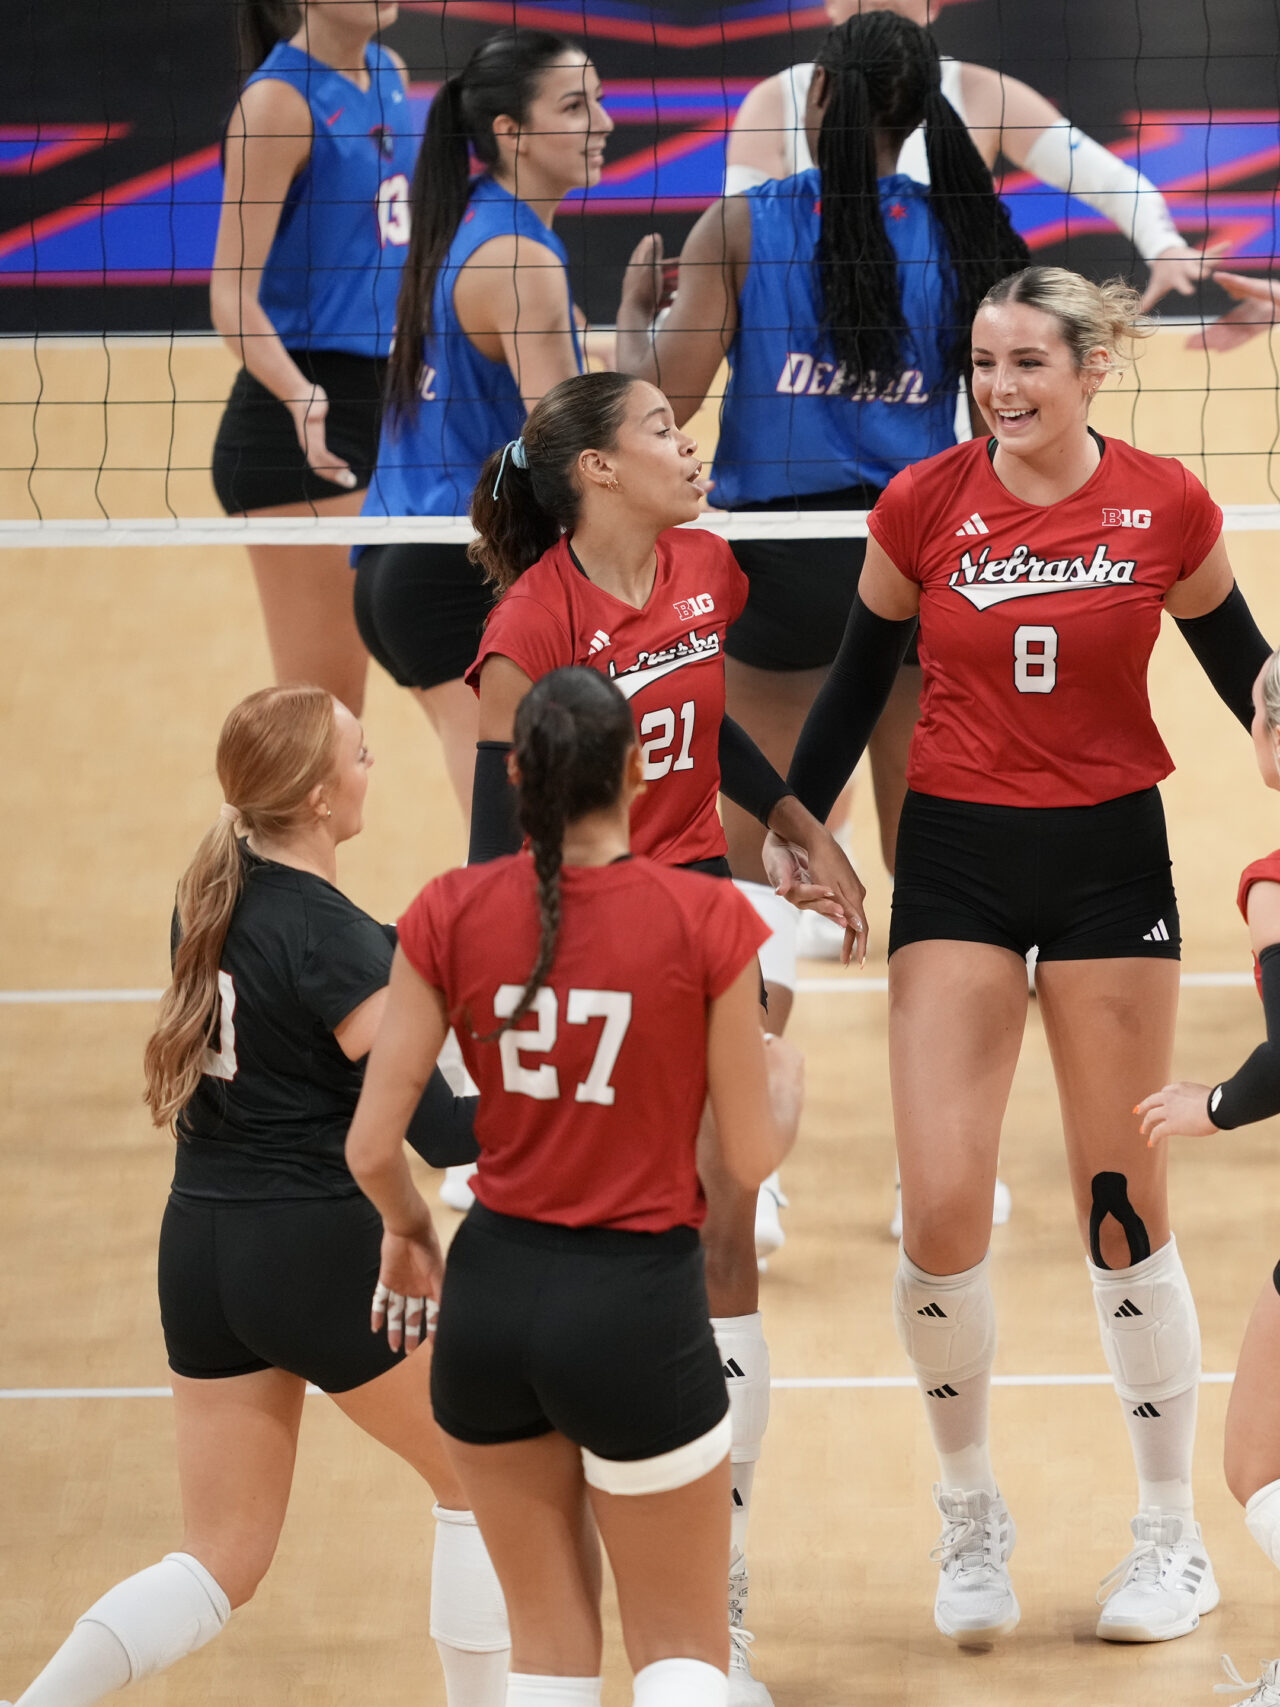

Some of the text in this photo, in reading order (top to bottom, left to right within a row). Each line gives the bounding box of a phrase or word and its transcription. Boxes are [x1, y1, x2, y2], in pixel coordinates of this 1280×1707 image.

[949, 543, 1137, 588] Nebraska
[1013, 624, 1059, 694] 8
[640, 700, 696, 781] 21
[493, 983, 633, 1106] 27
